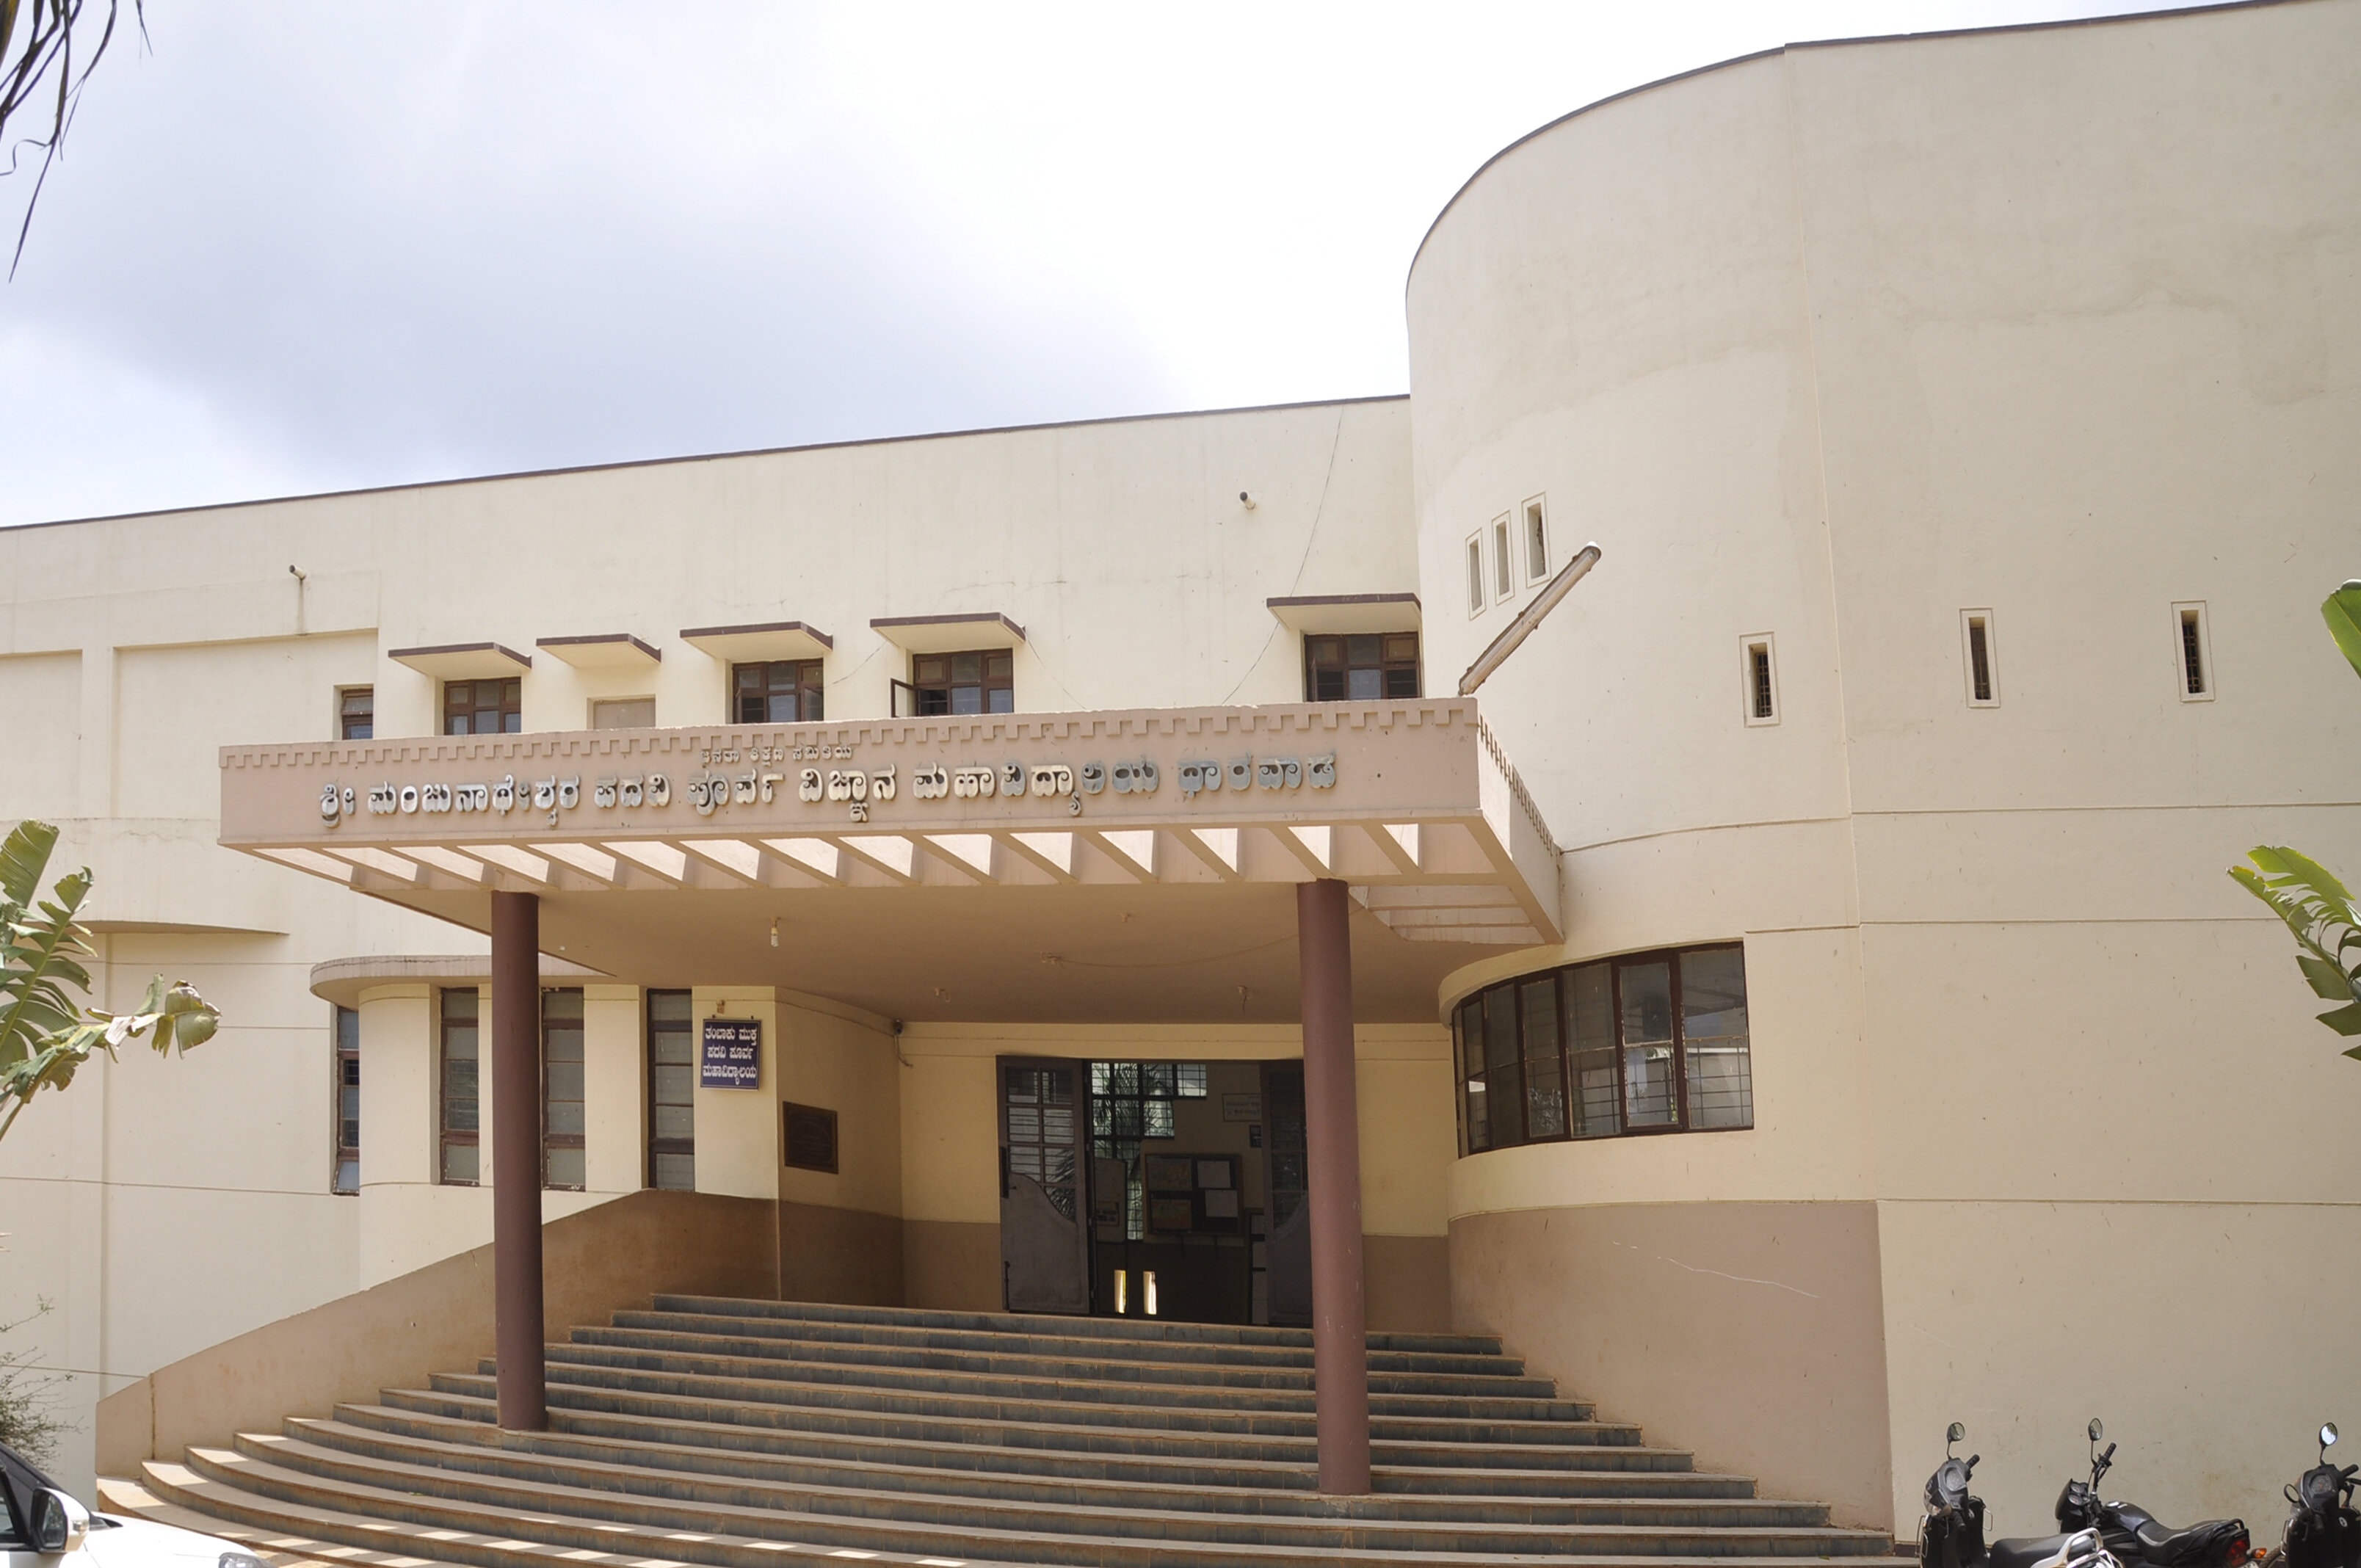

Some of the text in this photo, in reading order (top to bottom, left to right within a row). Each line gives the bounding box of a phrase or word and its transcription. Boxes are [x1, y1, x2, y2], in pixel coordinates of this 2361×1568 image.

[321, 752, 1336, 828] ಶ್ರೀ ಮಂಜುನಾಥೇಶ್ವರ ಪದವಿ ಪೂರ್ವ ವಿಜ್ಞಾನ ಮಹಾವಿದ್ಯಾಲಯ ಧಾರವಾಡ
